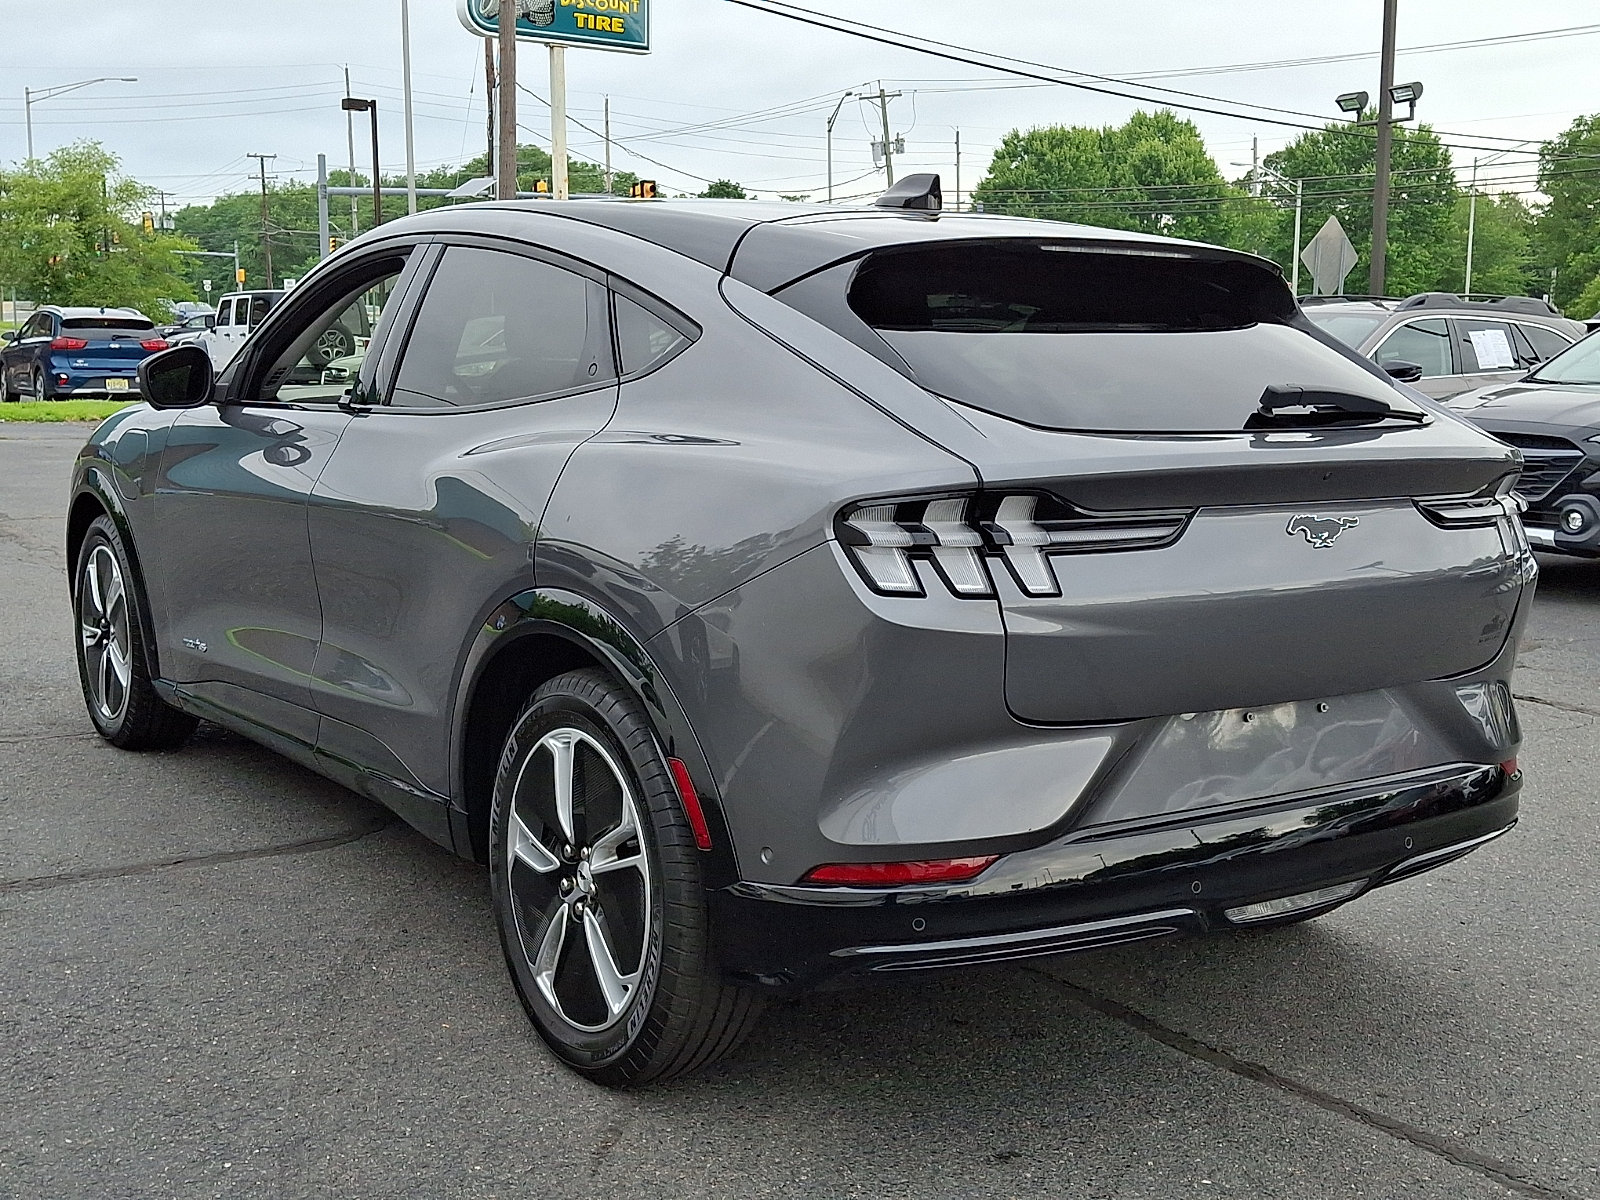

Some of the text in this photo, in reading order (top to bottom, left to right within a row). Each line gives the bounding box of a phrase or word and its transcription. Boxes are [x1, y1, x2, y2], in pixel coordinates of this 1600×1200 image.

[560, 0, 639, 14] SCOUNT
[573, 13, 625, 33] TIRE
[492, 742, 516, 836] MICLIN
[629, 930, 659, 1034] MICHELIN
